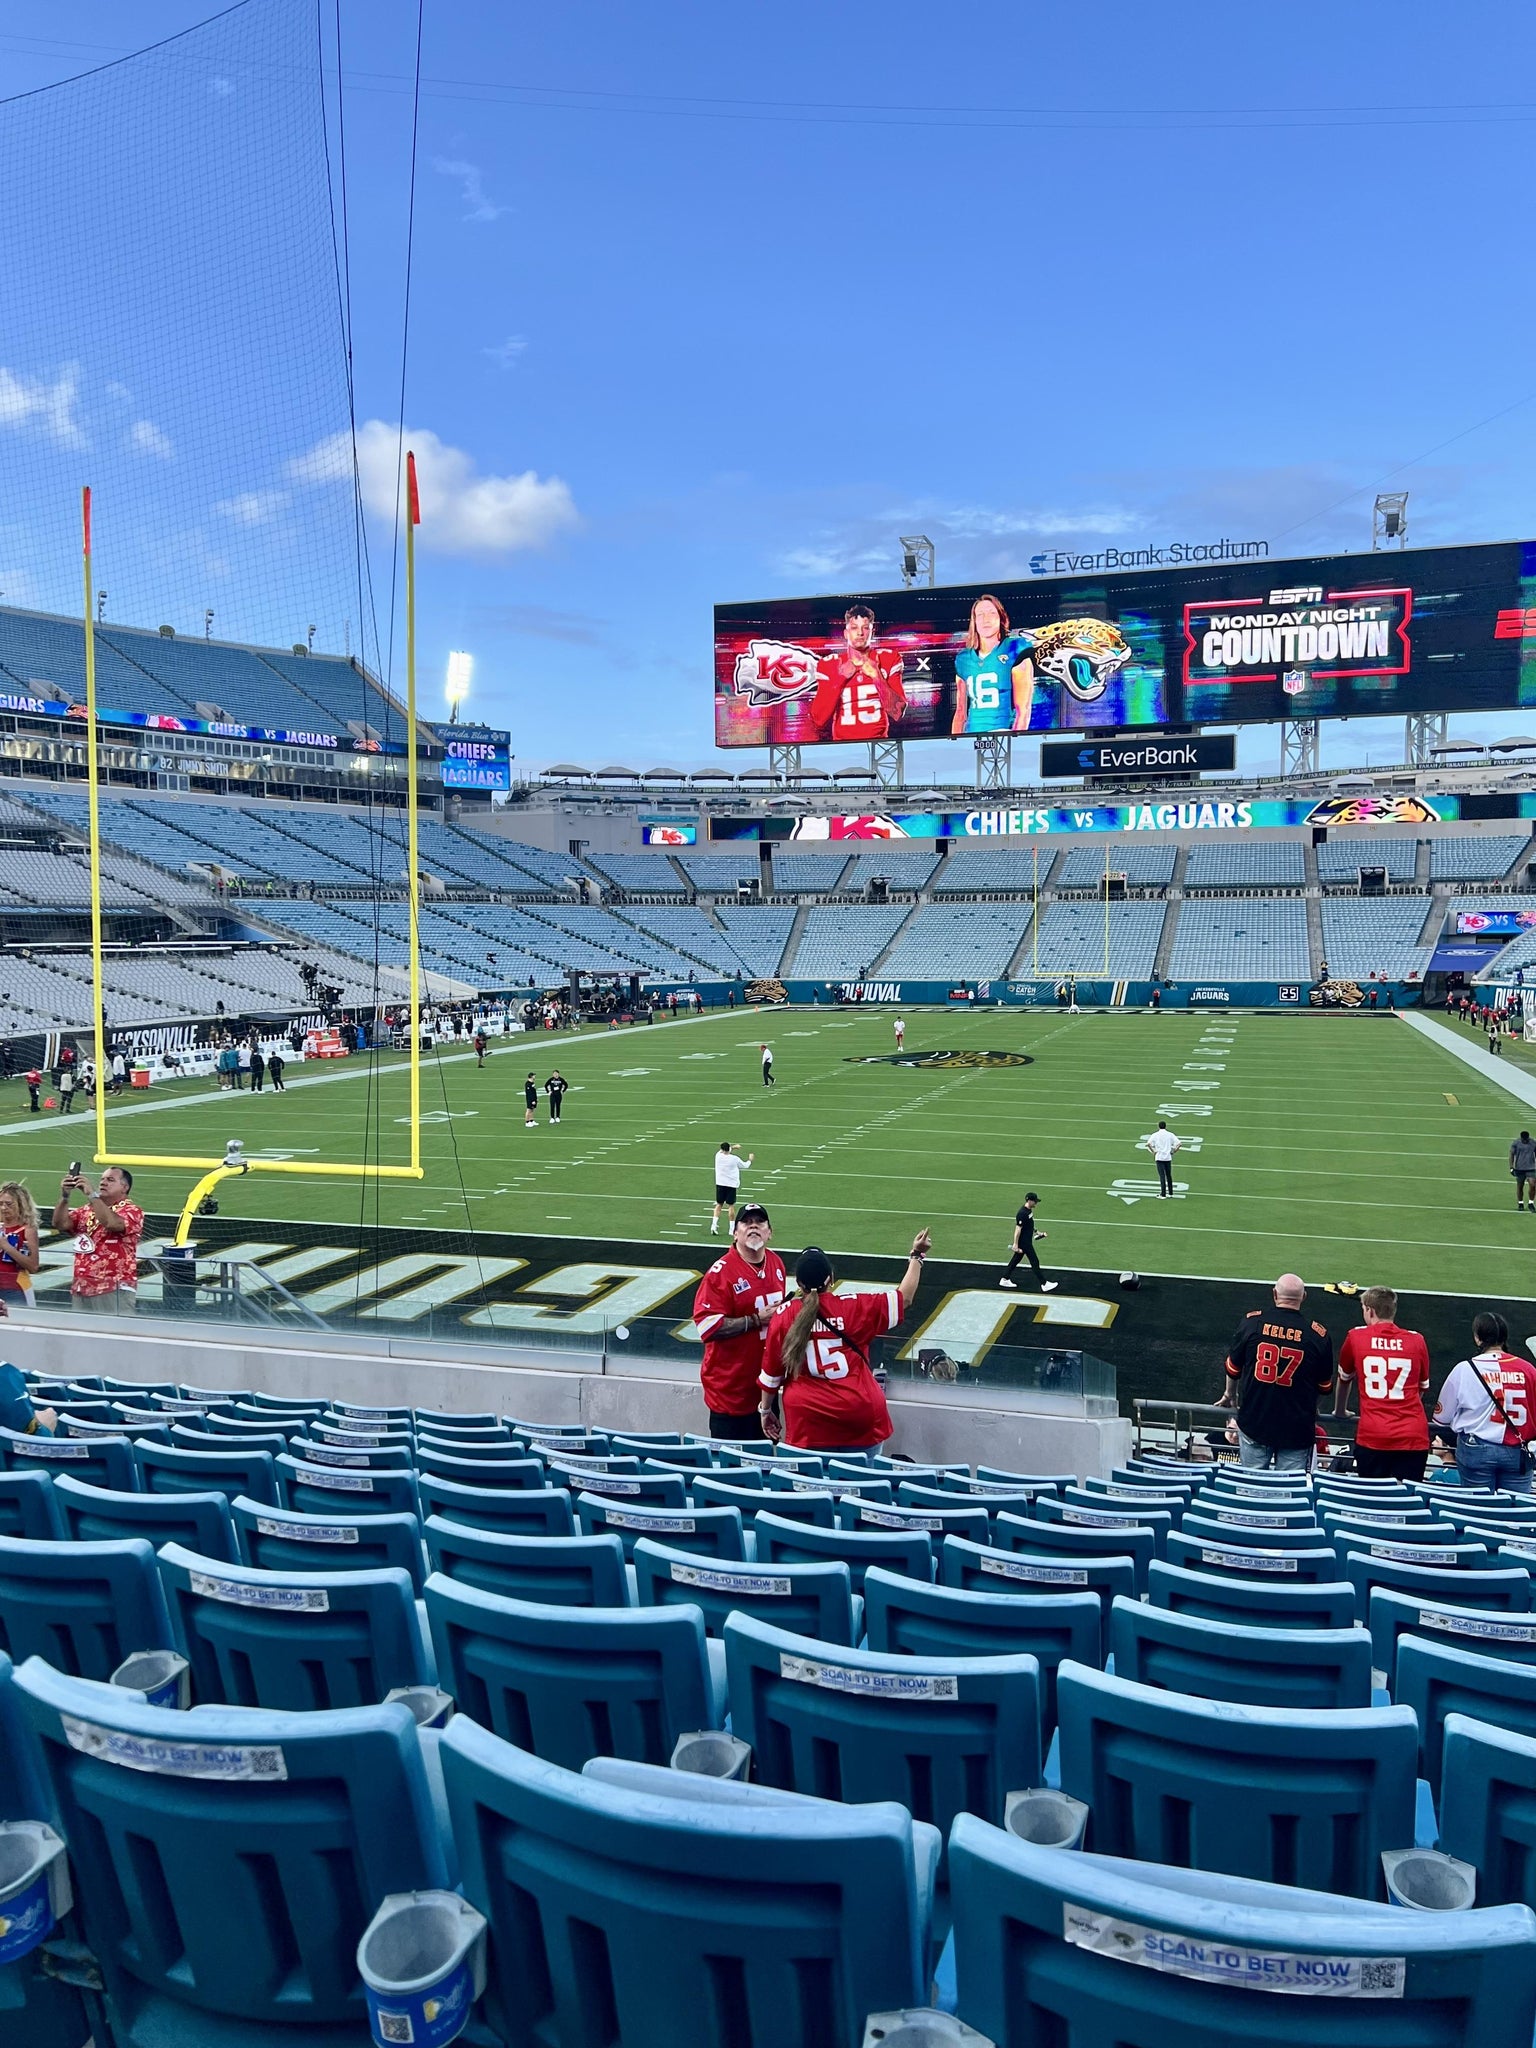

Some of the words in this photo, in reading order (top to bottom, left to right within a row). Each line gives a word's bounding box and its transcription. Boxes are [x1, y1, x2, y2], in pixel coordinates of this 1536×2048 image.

[1054, 544, 1161, 573] EverBank
[1169, 538, 1269, 562] Stadium
[1268, 587, 1323, 605] ESPN
[1210, 612, 1306, 630] MONDAY
[1310, 607, 1381, 623] NIGHT
[1203, 620, 1389, 667] COUNTDOWN
[840, 684, 882, 726] 15
[207, 721, 248, 738] CHIEFS
[264, 728, 276, 740] VS
[284, 730, 338, 748] JAGUARS
[447, 741, 496, 760] CHIEFS
[1100, 745, 1198, 767] EverBank
[467, 759, 477, 768] VS
[442, 768, 504, 787] JAGUARS
[964, 809, 1050, 836] CHIEFS
[1074, 811, 1094, 828] VS
[1123, 802, 1253, 832] JAGUARS
[1494, 914, 1509, 926] VS
[1190, 991, 1230, 1001] JAGUARS
[1281, 988, 1297, 999] 25
[1262, 1323, 1303, 1343] KELCE
[1371, 1337, 1404, 1351] KELCE
[805, 1337, 850, 1380] 15
[1254, 1341, 1305, 1388] 87
[1363, 1355, 1412, 1400] 87
[1490, 1388, 1528, 1427] 15
[698, 1571, 719, 1581] SCAN
[720, 1576, 731, 1584] TO
[734, 1577, 748, 1585] BET
[750, 1578, 771, 1586] NOW
[1006, 1565, 1026, 1573] SCAN
[1038, 1569, 1052, 1577] BET
[1053, 1570, 1071, 1578] NOW
[219, 1582, 241, 1593] SCAN
[244, 1588, 256, 1598] TO
[259, 1589, 278, 1599] BET
[280, 1590, 303, 1600] NOW
[1451, 1619, 1476, 1630] SCAN
[1477, 1624, 1489, 1632] TO
[1490, 1626, 1505, 1634] BET
[1507, 1627, 1528, 1635] NOW
[821, 1667, 852, 1681] SCAN
[855, 1674, 870, 1685] TO
[874, 1677, 895, 1687] BET
[899, 1679, 928, 1688] NOW
[107, 1735, 145, 1754] SCAN
[147, 1743, 168, 1761] TO
[172, 1748, 198, 1762] BET
[203, 1749, 243, 1764] NOW
[1144, 1933, 1205, 1961] SCAN
[1211, 1950, 1240, 1969] TO
[1248, 1956, 1289, 1974] BET
[1296, 1961, 1351, 1978] NOW
